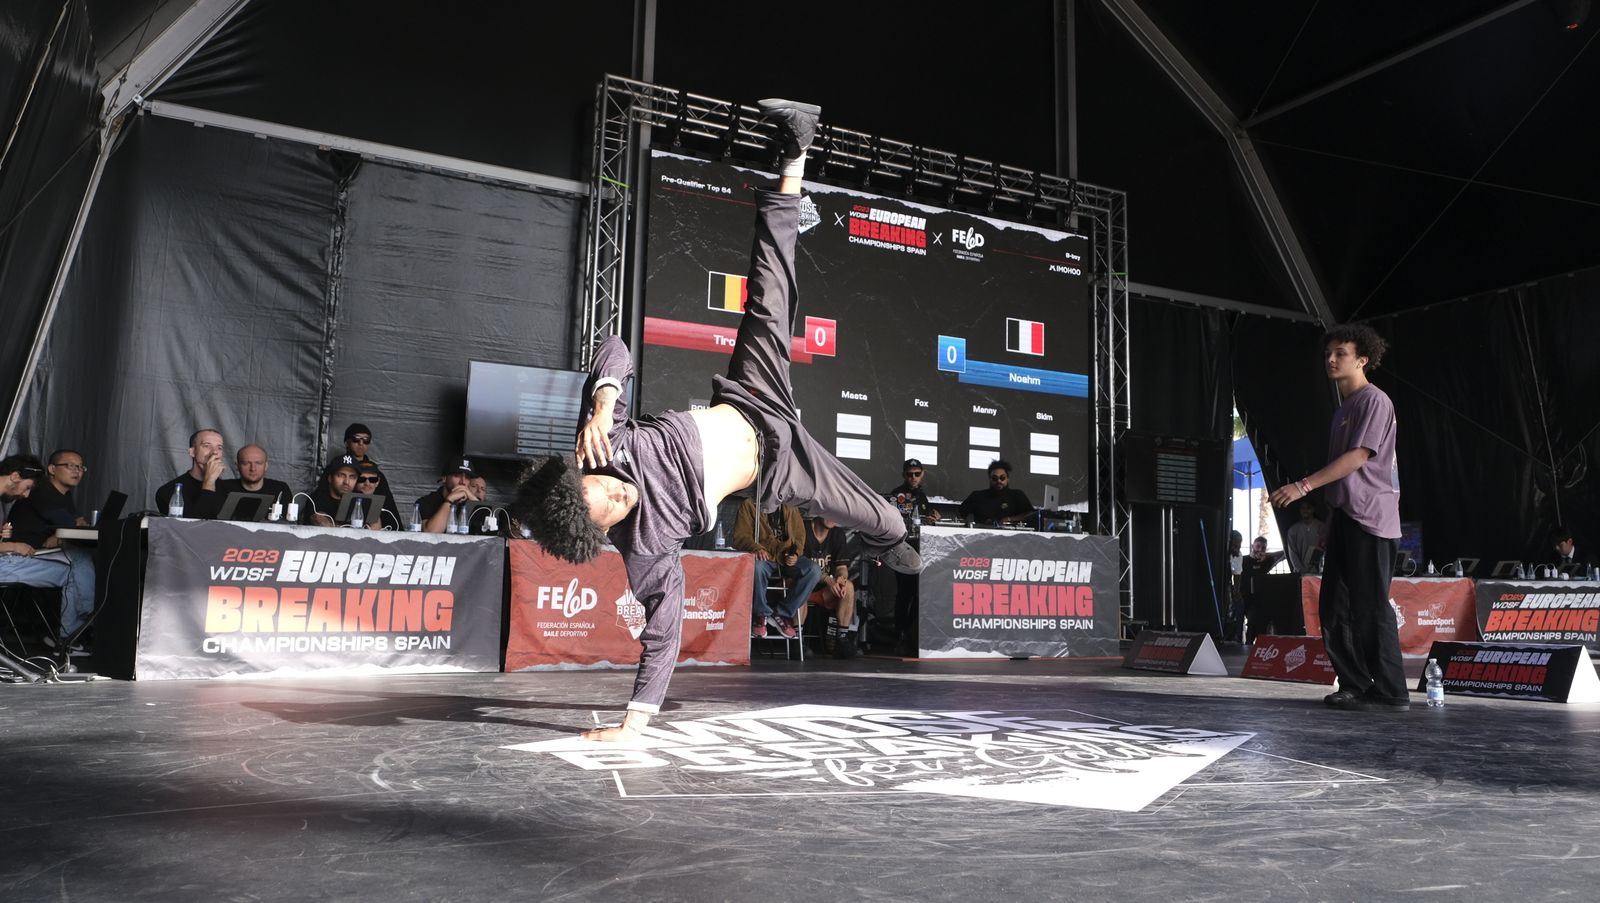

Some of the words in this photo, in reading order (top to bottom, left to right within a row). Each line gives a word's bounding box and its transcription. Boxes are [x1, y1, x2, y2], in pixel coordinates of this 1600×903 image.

[707, 184, 720, 192] Top
[869, 208, 927, 230] EUROPEAN
[849, 218, 926, 248] BREAKING
[849, 236, 905, 252] CHAMPIONSHIPS
[906, 246, 926, 256] SPAIN
[815, 328, 826, 346] 0
[947, 346, 957, 364] 0
[914, 399, 929, 407] Fox
[222, 548, 279, 564] 2023
[960, 557, 991, 567] 2023
[210, 566, 276, 581] WDSF
[276, 550, 456, 585] EUROPEAN
[953, 570, 989, 580] WDSF
[989, 558, 1092, 583] EUROPEAN
[953, 583, 1093, 616] BREAKING
[1520, 594, 1600, 609] EUROPEAN
[205, 586, 454, 632] BREAKING
[617, 605, 646, 615] BREA
[953, 618, 1056, 630] CHAMPIONSHIPS
[1060, 619, 1093, 630] SPAIN
[1485, 610, 1600, 632] BREAKING
[202, 636, 388, 653] CHAMPIONSHIPS
[395, 636, 451, 650] SPAIN
[1483, 632, 1561, 641] CHAMPIONSHIPS
[1563, 633, 1596, 642] SPAIN
[1473, 650, 1552, 665] EUROPEAN
[1444, 662, 1548, 684] BREAKING
[1442, 680, 1512, 690] CHAMPIONSHIPS
[550, 725, 1217, 770] BREAKING
